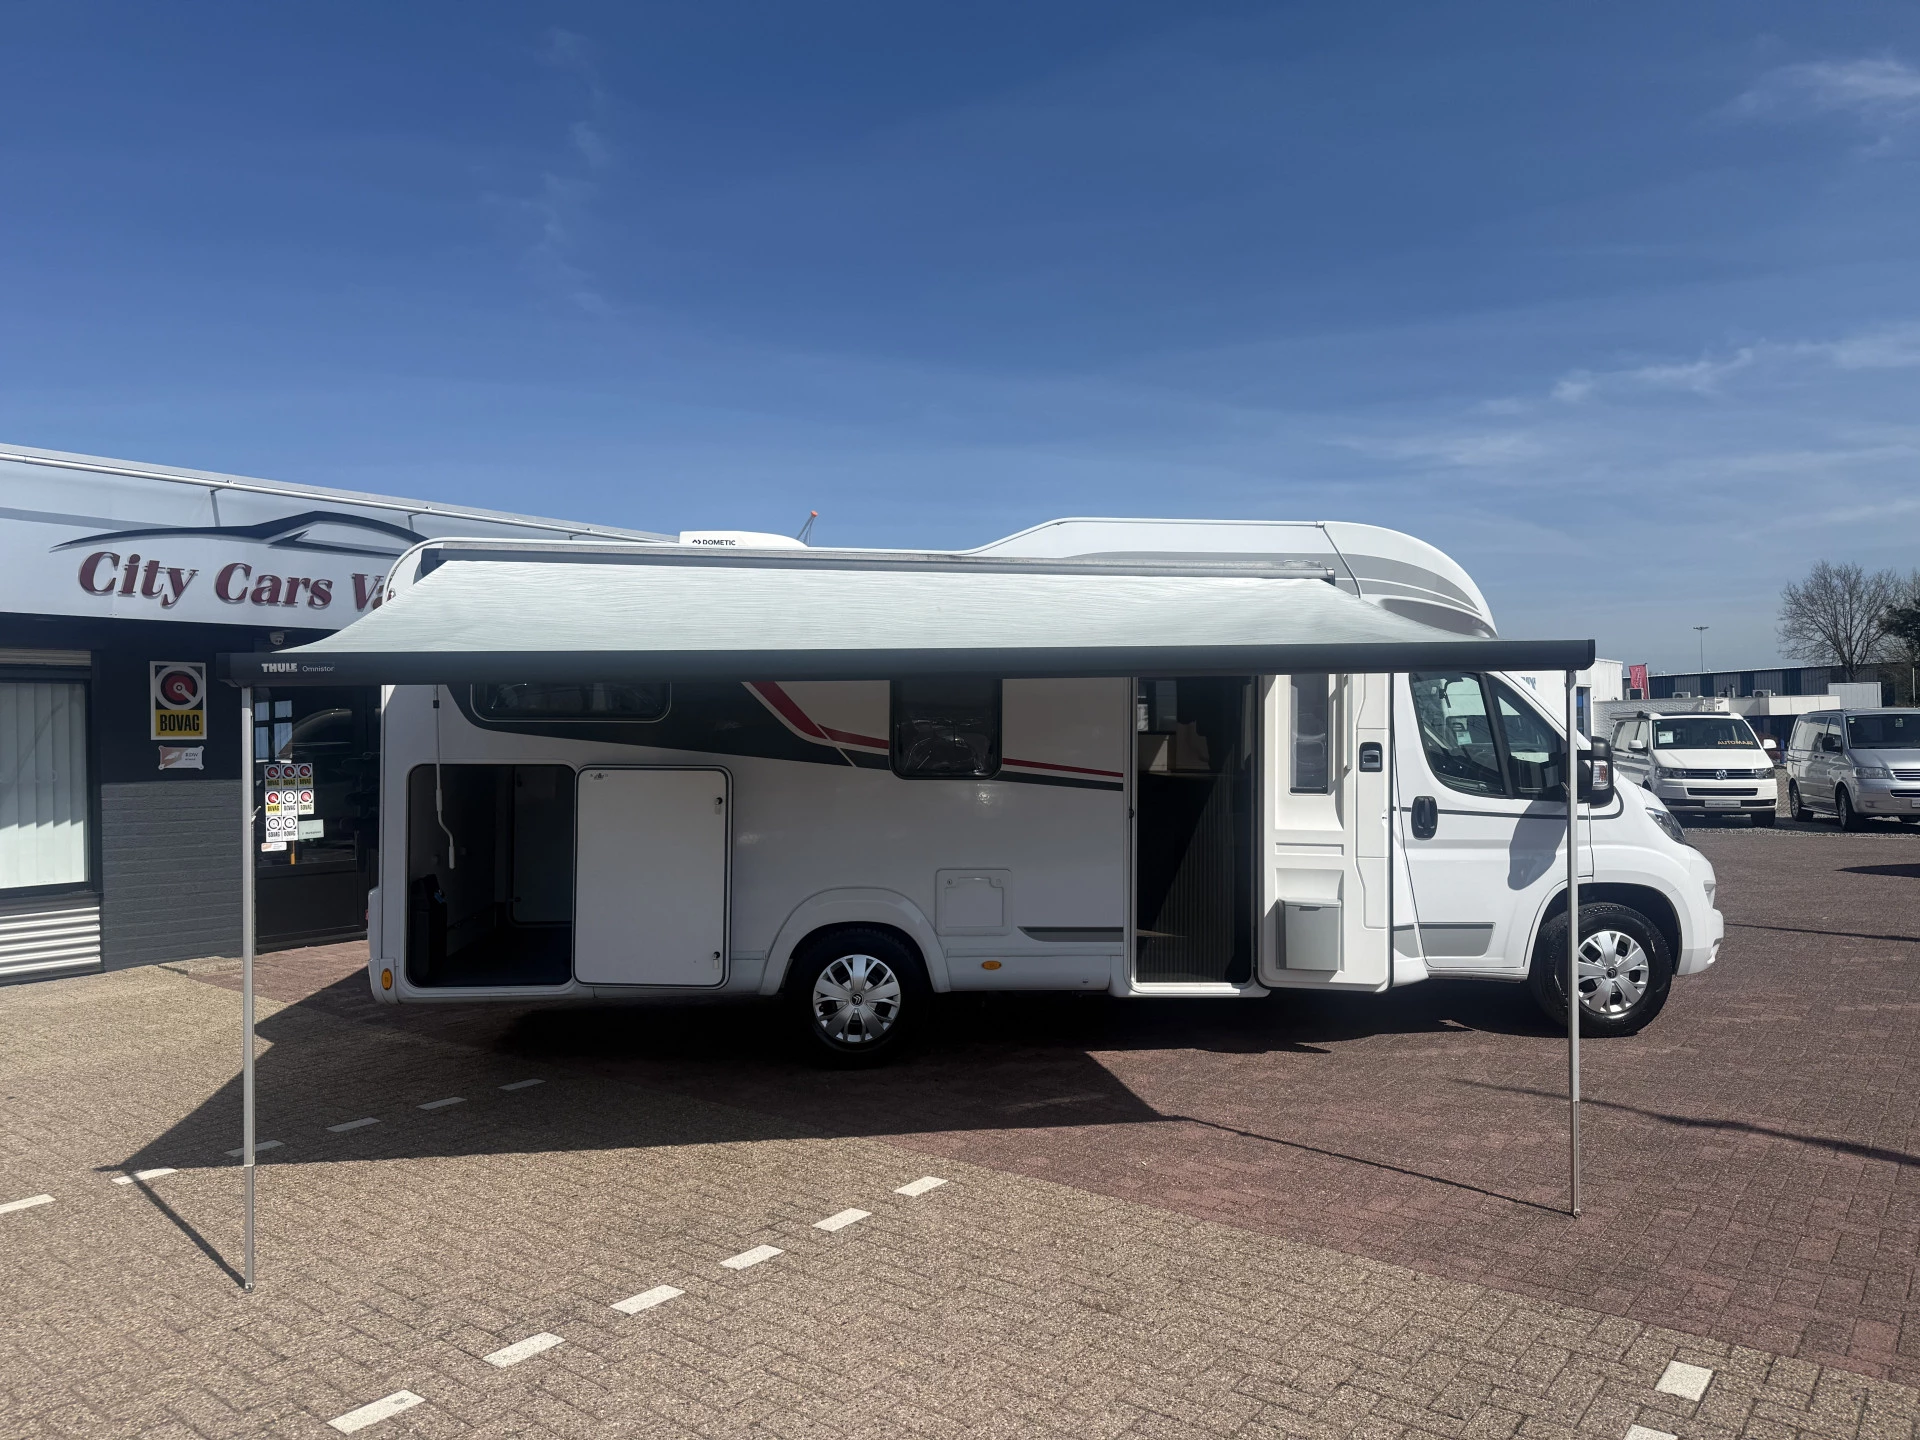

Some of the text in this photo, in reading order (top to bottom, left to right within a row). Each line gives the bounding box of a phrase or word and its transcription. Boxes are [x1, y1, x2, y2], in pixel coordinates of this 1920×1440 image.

[78, 551, 199, 608] City
[214, 562, 334, 608] Cars
[261, 662, 335, 673] THULE Omnistor
[159, 714, 200, 732] BOVAG
